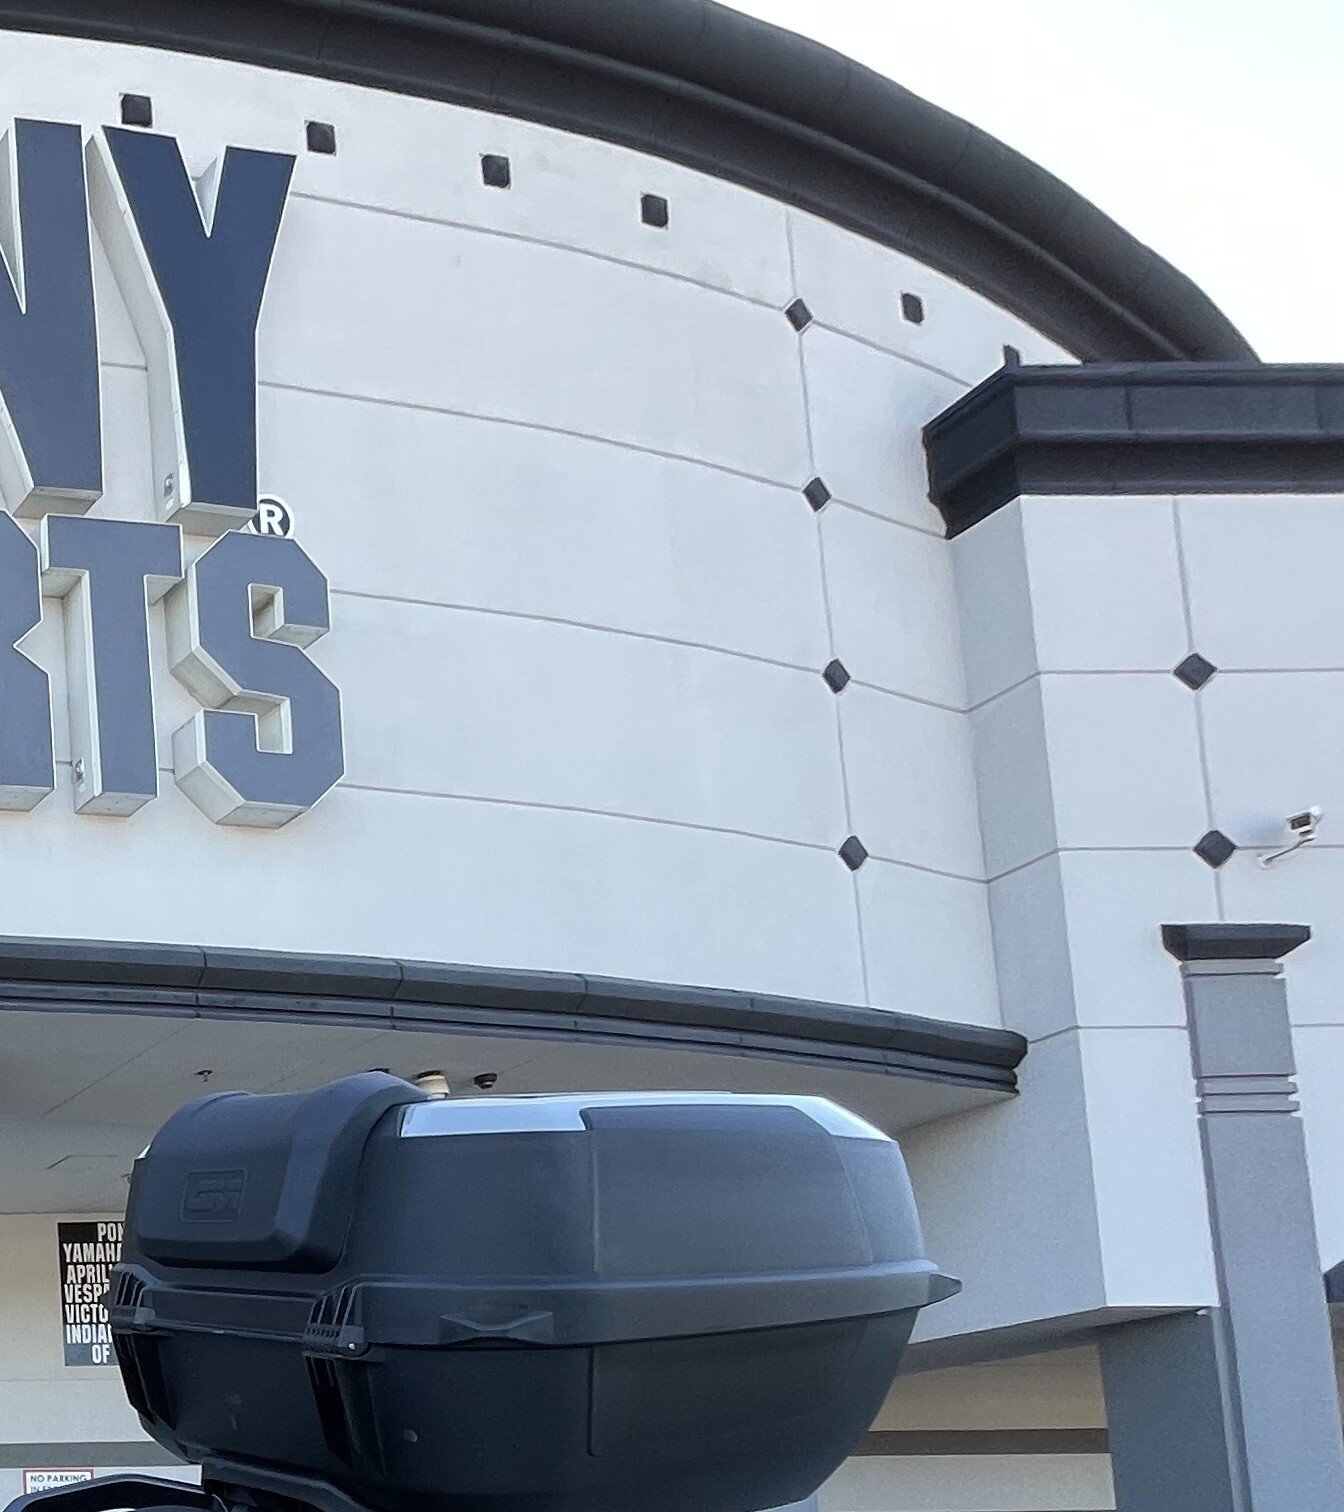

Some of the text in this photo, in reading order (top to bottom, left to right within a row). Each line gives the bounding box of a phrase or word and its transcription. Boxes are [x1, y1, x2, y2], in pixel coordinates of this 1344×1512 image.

[66, 1264, 112, 1284] APRIL
[91, 1344, 110, 1364] OF
[30, 1474, 87, 1483] NO PARKING
